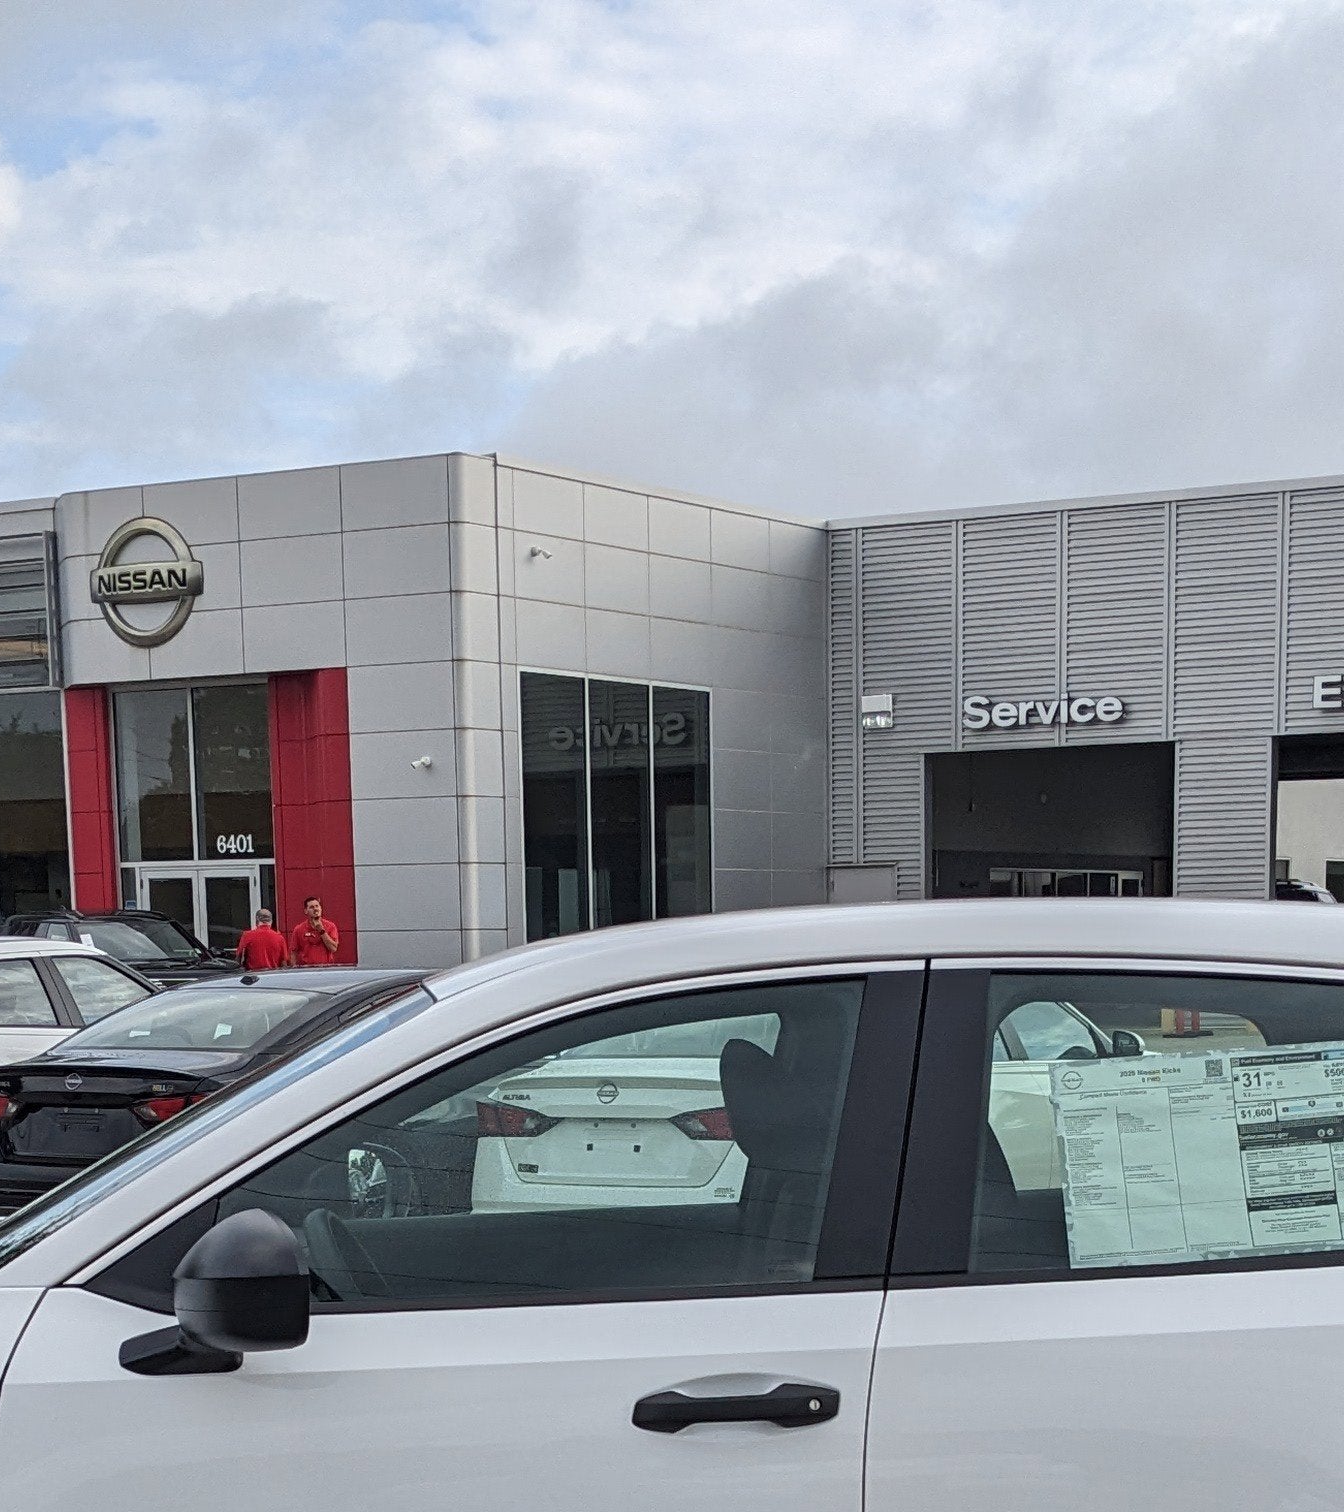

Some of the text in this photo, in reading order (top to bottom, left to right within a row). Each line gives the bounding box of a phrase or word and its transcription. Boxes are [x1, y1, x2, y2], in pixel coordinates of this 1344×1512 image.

[97, 567, 188, 594] NISSAN
[962, 694, 1125, 729] Service
[217, 834, 254, 854] 6401
[1242, 1072, 1261, 1087] 31
[1241, 1109, 1272, 1119] $1,600
